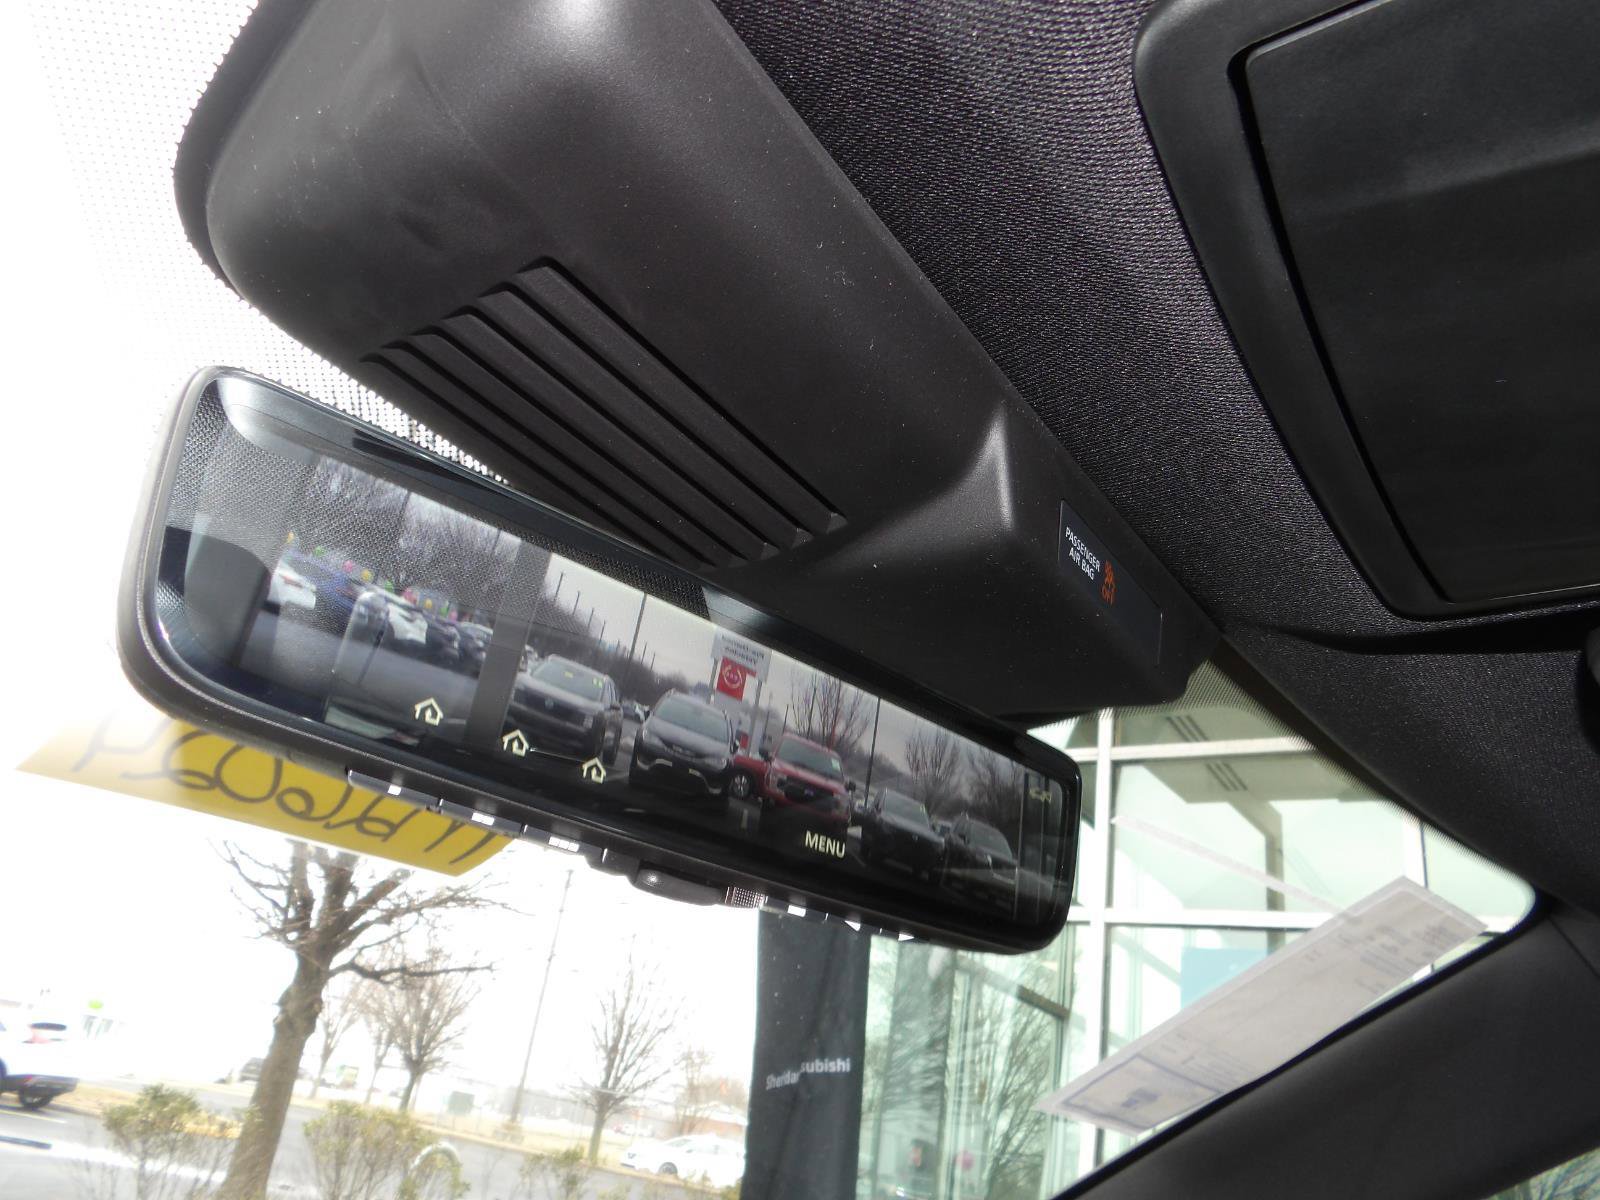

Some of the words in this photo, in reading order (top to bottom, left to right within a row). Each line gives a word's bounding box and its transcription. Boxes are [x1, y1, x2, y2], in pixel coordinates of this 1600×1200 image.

[1065, 527, 1101, 572] PASSENGER
[1068, 547, 1081, 567] AIR
[1081, 560, 1095, 580] BAG
[805, 830, 846, 858] MENU
